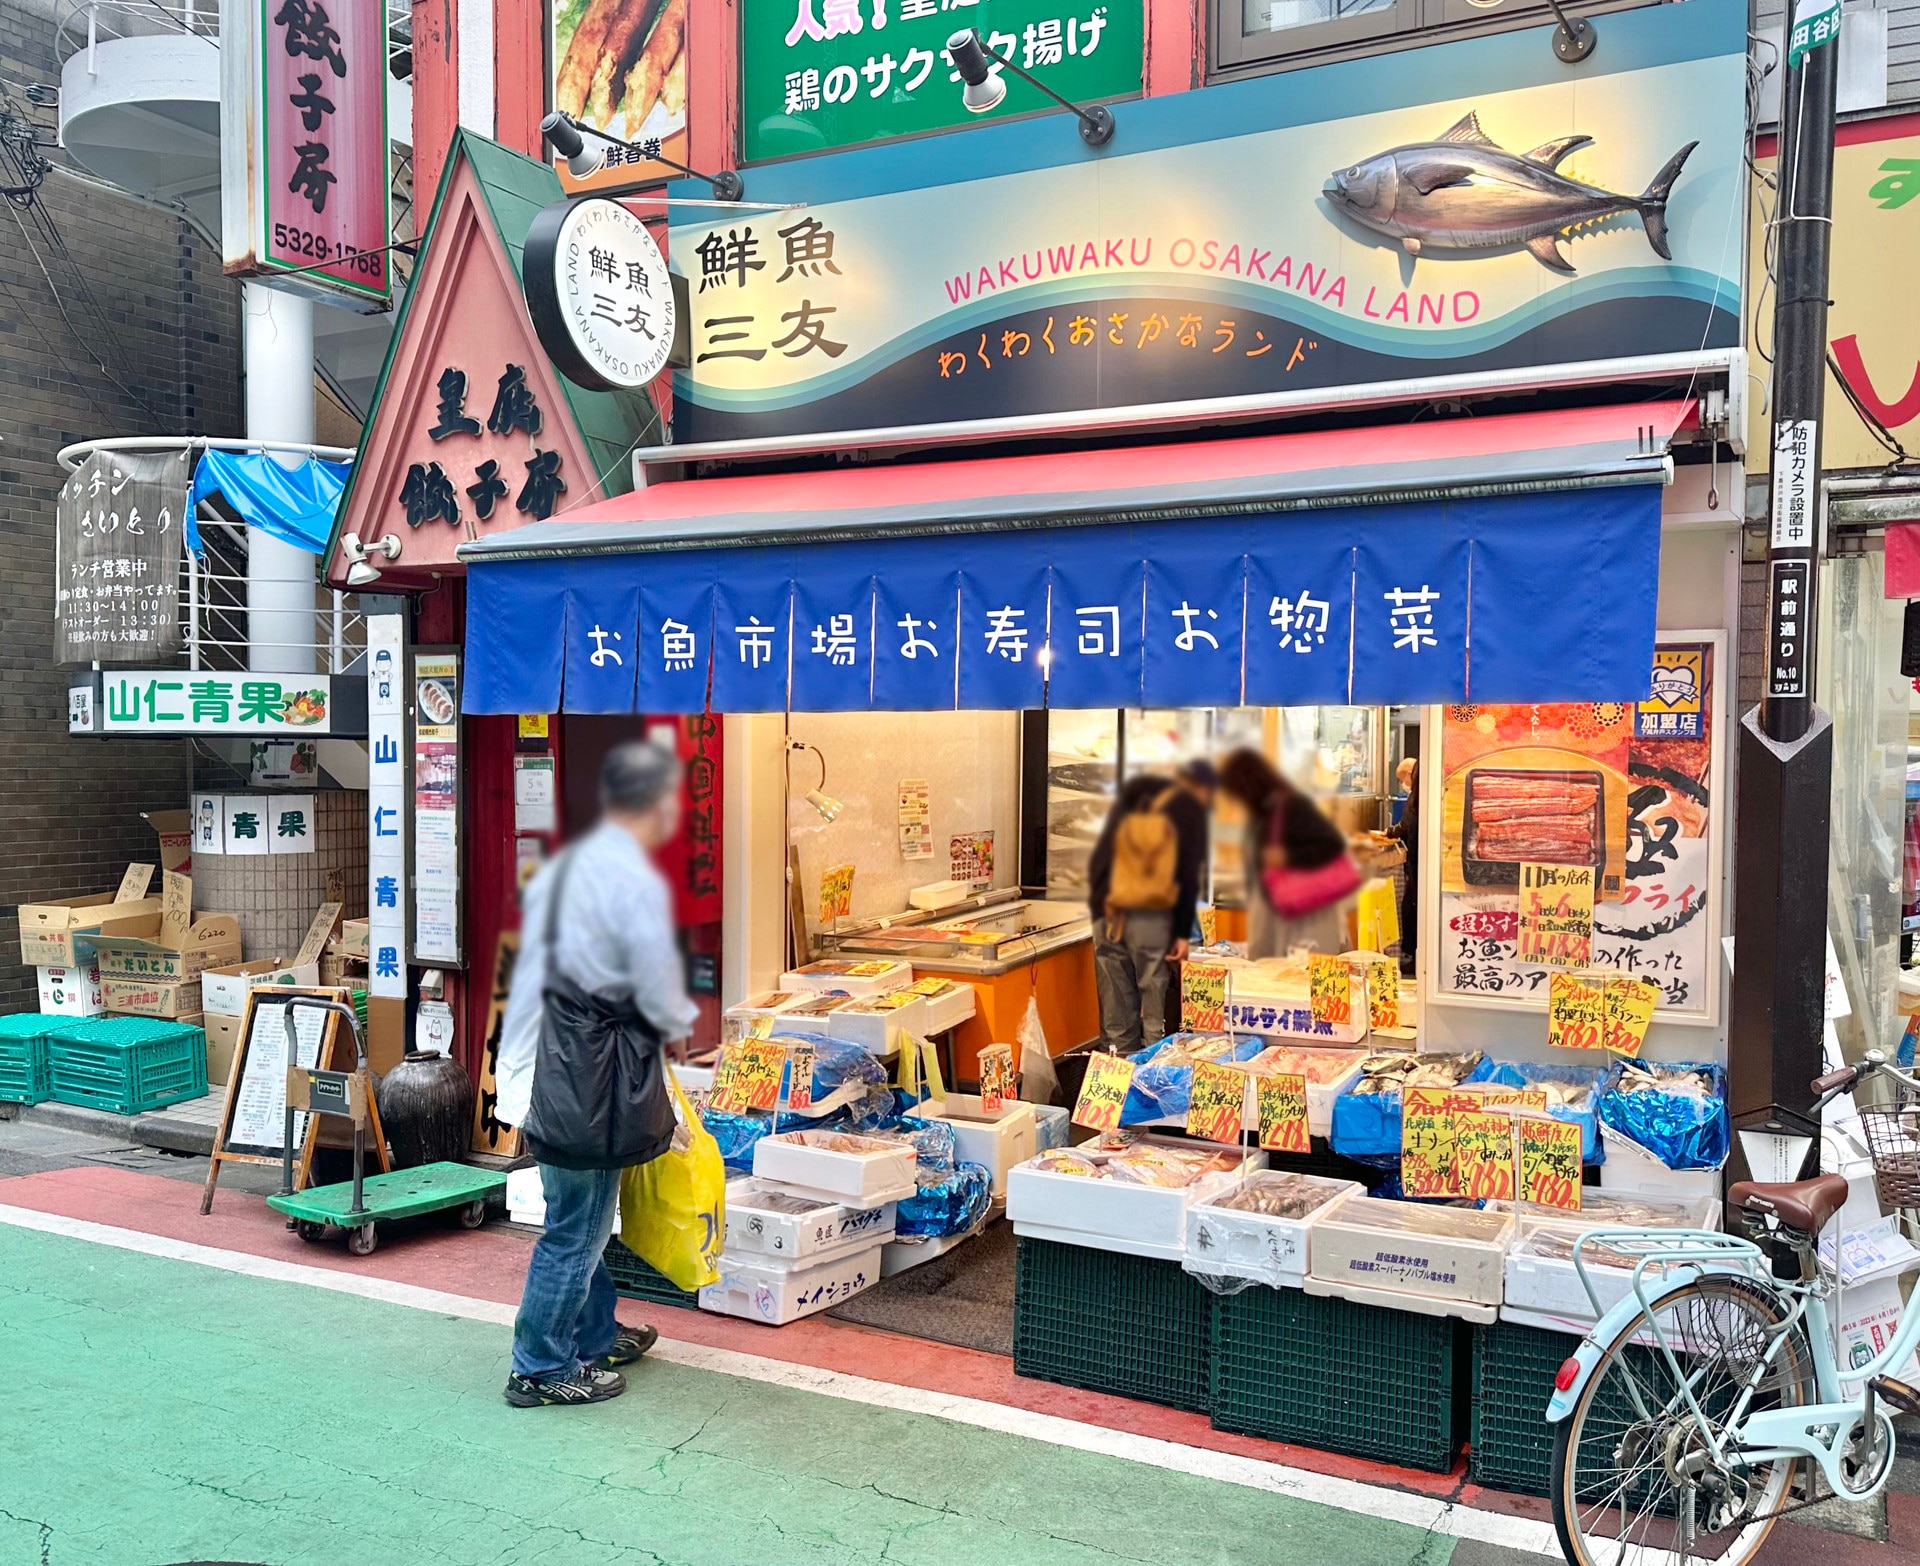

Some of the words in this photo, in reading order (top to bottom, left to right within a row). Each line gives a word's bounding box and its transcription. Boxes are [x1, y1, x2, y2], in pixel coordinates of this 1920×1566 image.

[599, 138, 662, 170] 鮮春巻
[274, 222, 382, 278] 5329-1768
[568, 242, 580, 296] LAND
[588, 245, 653, 300] 鮮魚
[694, 216, 843, 295] 鮮魚
[943, 237, 1153, 305] WAKUWAKU
[1169, 237, 1347, 308] OSAKANA
[1362, 285, 1481, 325] LAND
[575, 306, 629, 376] OSAKANA
[590, 293, 656, 342] 三友
[633, 301, 673, 378] WAKUWAKU
[696, 299, 849, 364] 三友
[937, 312, 1319, 379] わくわくおさかなランド
[1788, 425, 1808, 541] 防犯カメラ設置中
[70, 558, 148, 579] ランチ営業中
[587, 584, 1441, 672] お魚市場お寿司お惣菜
[1780, 579, 1798, 657] 駅前通り
[1776, 666, 1797, 679] No.10
[109, 679, 285, 724] 山仁青果
[1641, 713, 1697, 730] 加盟店
[232, 811, 306, 839] 青果
[374, 734, 399, 978] 山仁青果
[198, 928, 226, 941] 6220
[1454, 913, 1519, 933] 超おす
